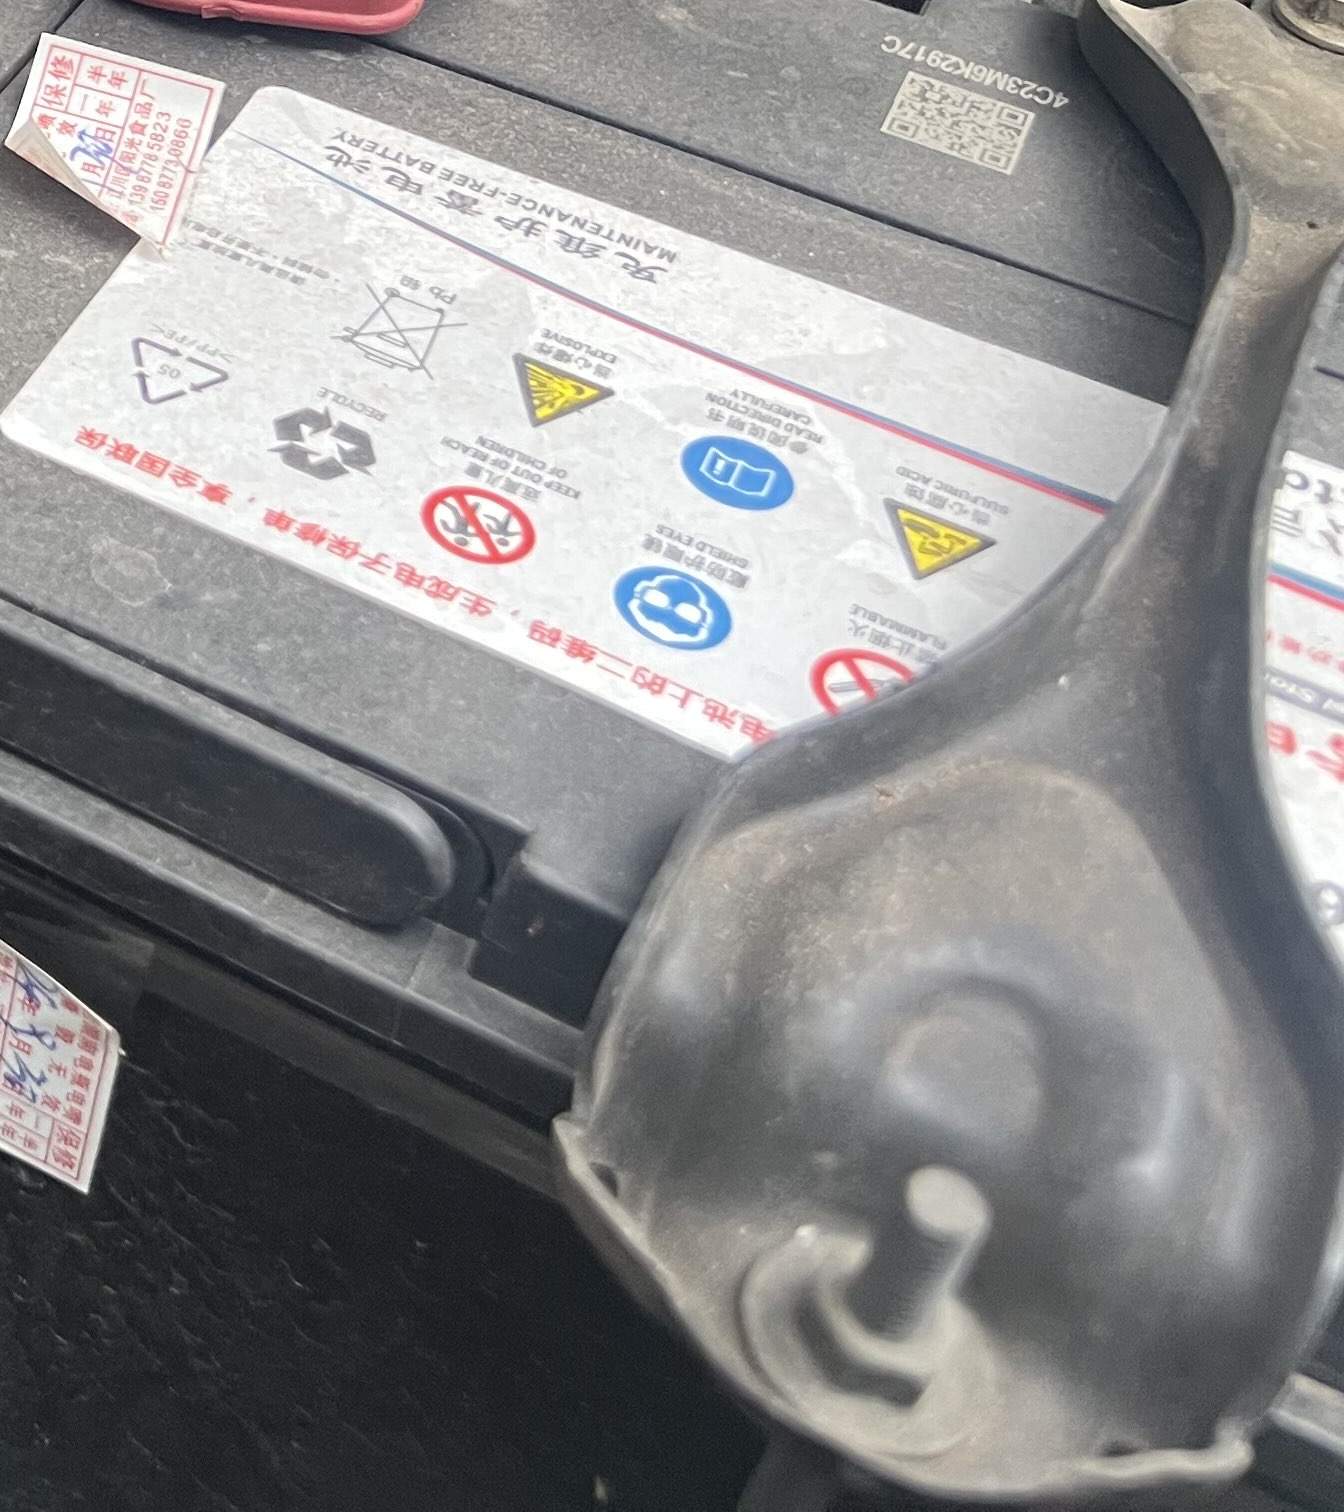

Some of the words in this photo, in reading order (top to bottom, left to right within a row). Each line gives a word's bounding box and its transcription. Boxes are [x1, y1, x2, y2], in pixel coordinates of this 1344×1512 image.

[37, 52, 78, 109] 保修
[880, 35, 1070, 109] 4C23M6K2917C
[330, 129, 438, 176] BATTERY
[312, 143, 671, 285] 免维护蓄电池
[433, 166, 682, 264] MAINTENANCE-FREE
[422, 284, 459, 305] Pb
[536, 327, 620, 364] EXPLOSIVE
[313, 384, 390, 422] RECYCLE
[701, 391, 785, 428] DIRECTION
[726, 387, 815, 426] CAREFULLY
[437, 434, 491, 462] REACH
[780, 421, 827, 444] READ
[471, 434, 549, 471] CHILDREN
[484, 454, 512, 470] OF
[507, 463, 546, 484] OUT
[540, 477, 584, 500] KEEP
[544, 464, 570, 480] OF
[890, 464, 934, 486] ACID
[649, 522, 697, 547] EYES
[689, 538, 752, 569] SHIELD
[49, 1121, 81, 1173] 保修
